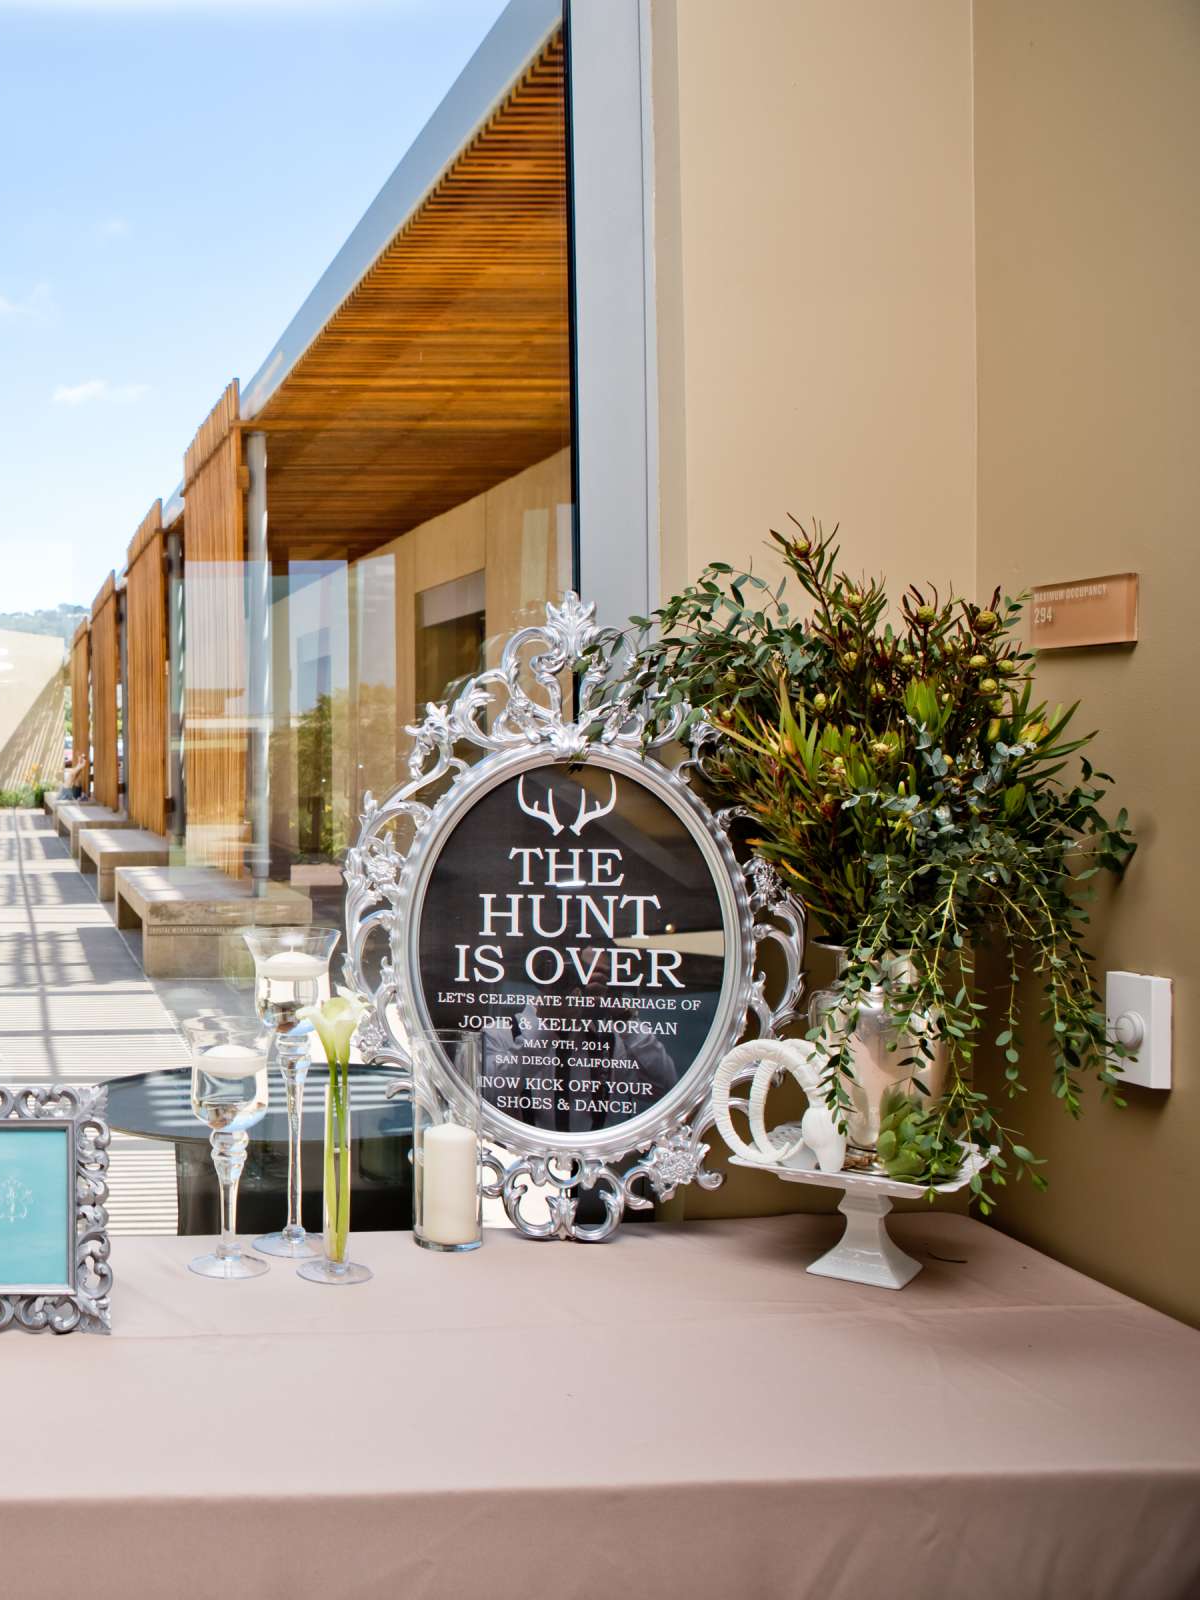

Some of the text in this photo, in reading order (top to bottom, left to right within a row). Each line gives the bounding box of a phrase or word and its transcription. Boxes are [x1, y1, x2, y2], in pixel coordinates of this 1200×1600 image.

[1034, 585, 1107, 601] MAXIMUM OCCUPANCY
[1034, 606, 1052, 624] 294
[508, 847, 625, 887] THE
[478, 893, 661, 939] HUNT
[454, 944, 686, 988] IS OVER
[438, 992, 702, 1011] LET'S CELEBRATE THE MARRIAGE OF
[458, 1016, 678, 1035] JODIE & KELLY MORGAN
[524, 1039, 610, 1052] MAY 9TH, 2014
[496, 1055, 640, 1070] SAN DIEGO, CALIFORNIA
[481, 1077, 653, 1095] NOW KICK OFF YOUR
[496, 1096, 637, 1114] SHOES & DANCE!
